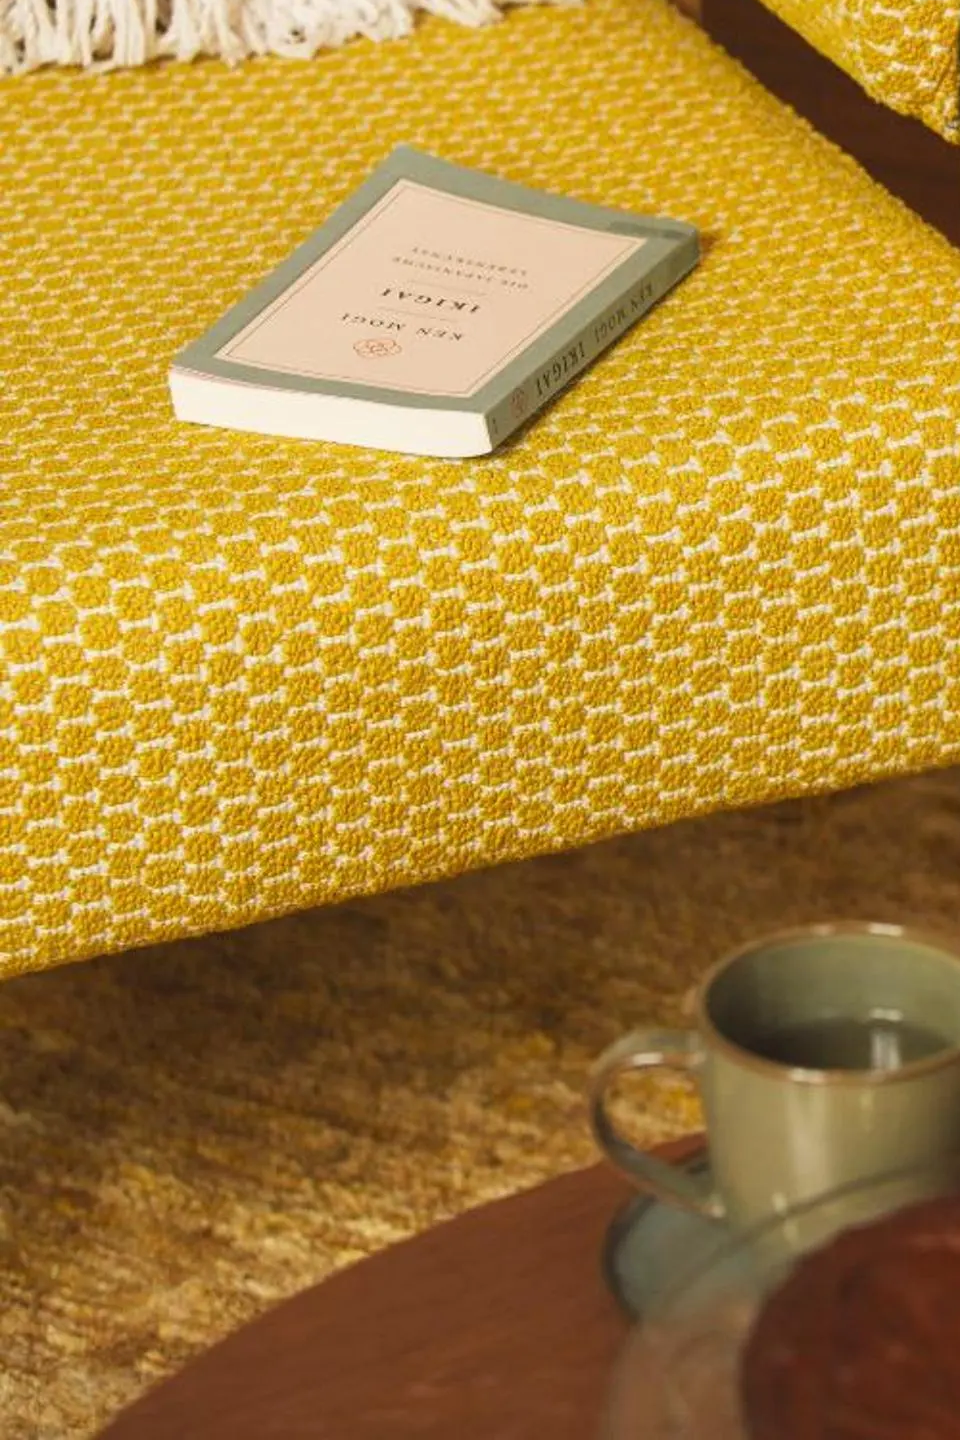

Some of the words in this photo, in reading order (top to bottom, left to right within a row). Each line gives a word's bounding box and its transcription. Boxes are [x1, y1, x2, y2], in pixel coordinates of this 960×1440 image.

[381, 287, 481, 314] IKIGAI
[341, 312, 407, 331] MOGI
[415, 326, 463, 341] KEN
[593, 310, 627, 344] MOGI
[535, 341, 585, 397] IKIGAI
